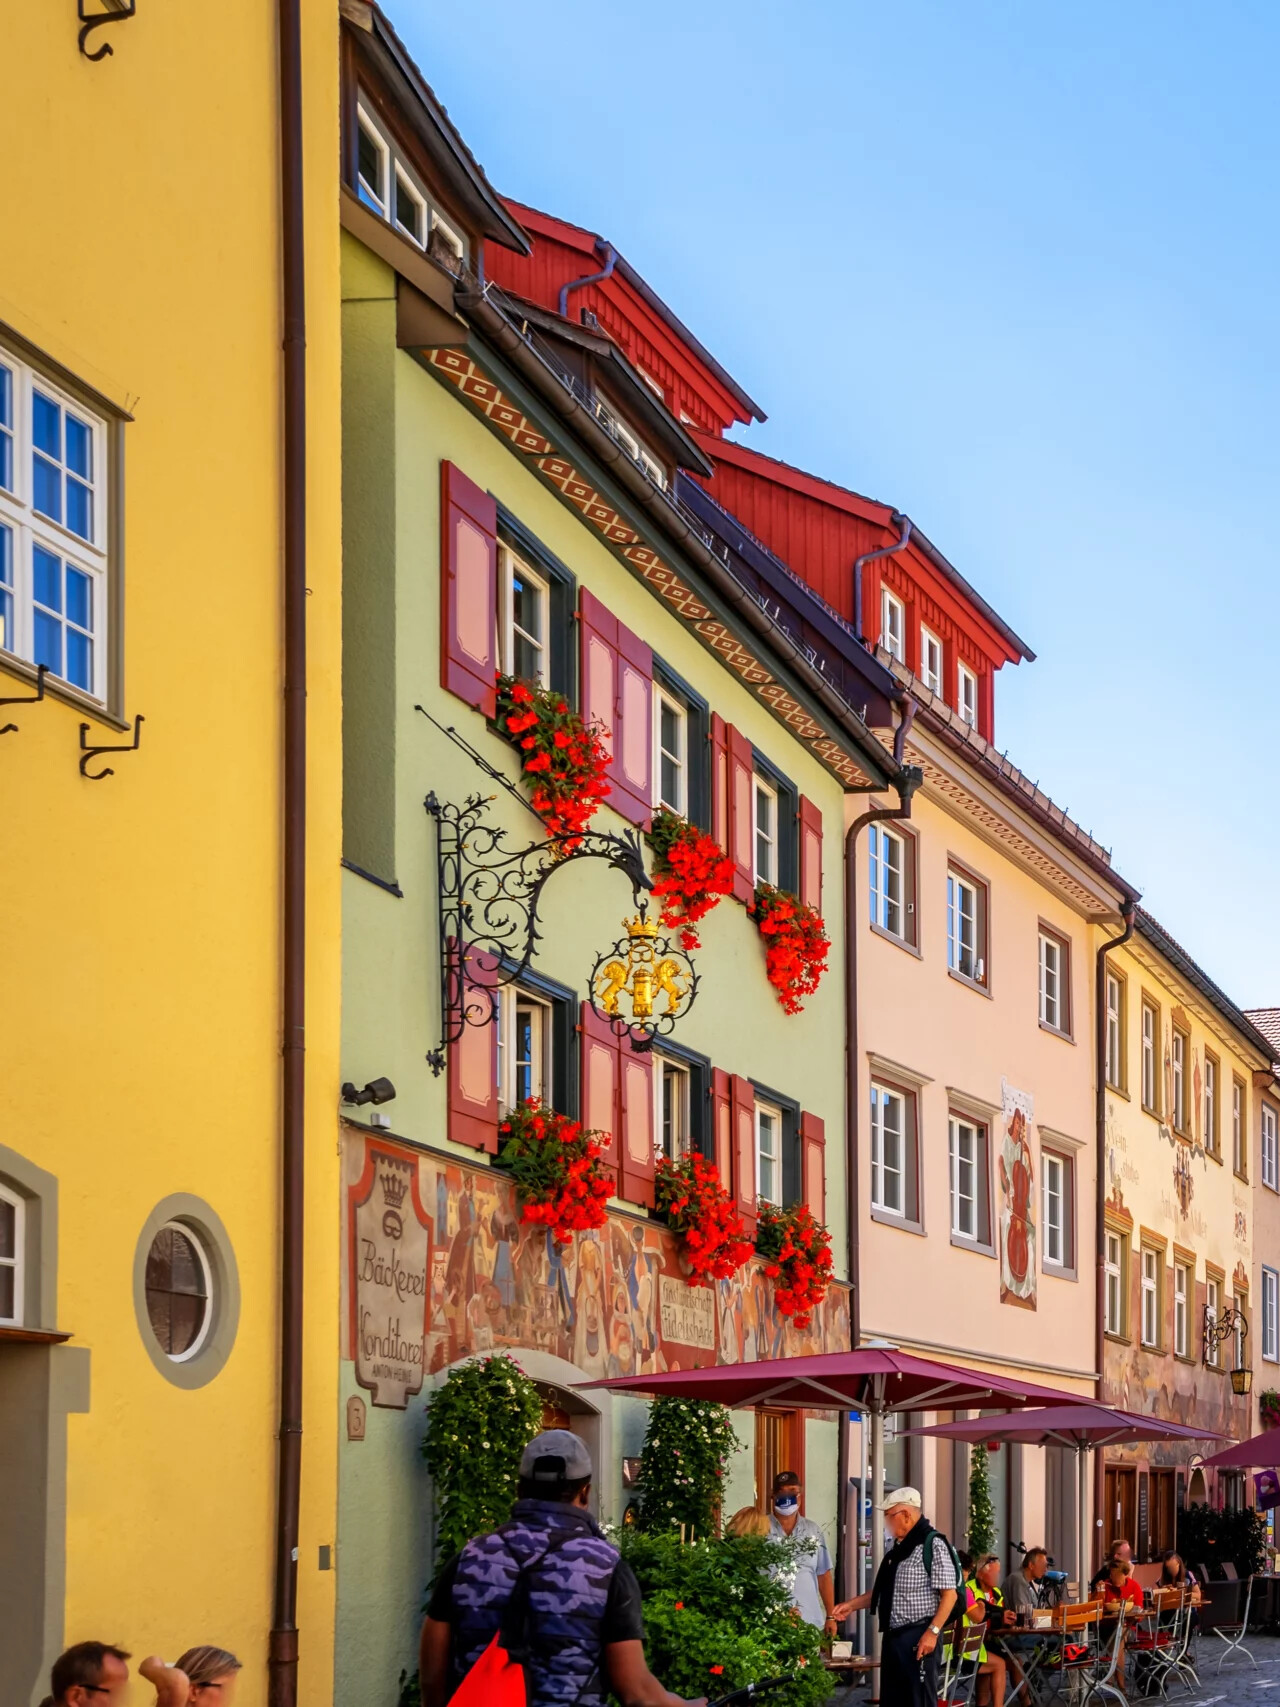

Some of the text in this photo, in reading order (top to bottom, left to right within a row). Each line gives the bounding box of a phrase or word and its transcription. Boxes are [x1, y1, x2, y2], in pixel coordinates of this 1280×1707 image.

[358, 1238, 427, 1303] Bäckerei
[359, 1304, 424, 1366] Konditorei
[353, 1408, 362, 1432] 3
